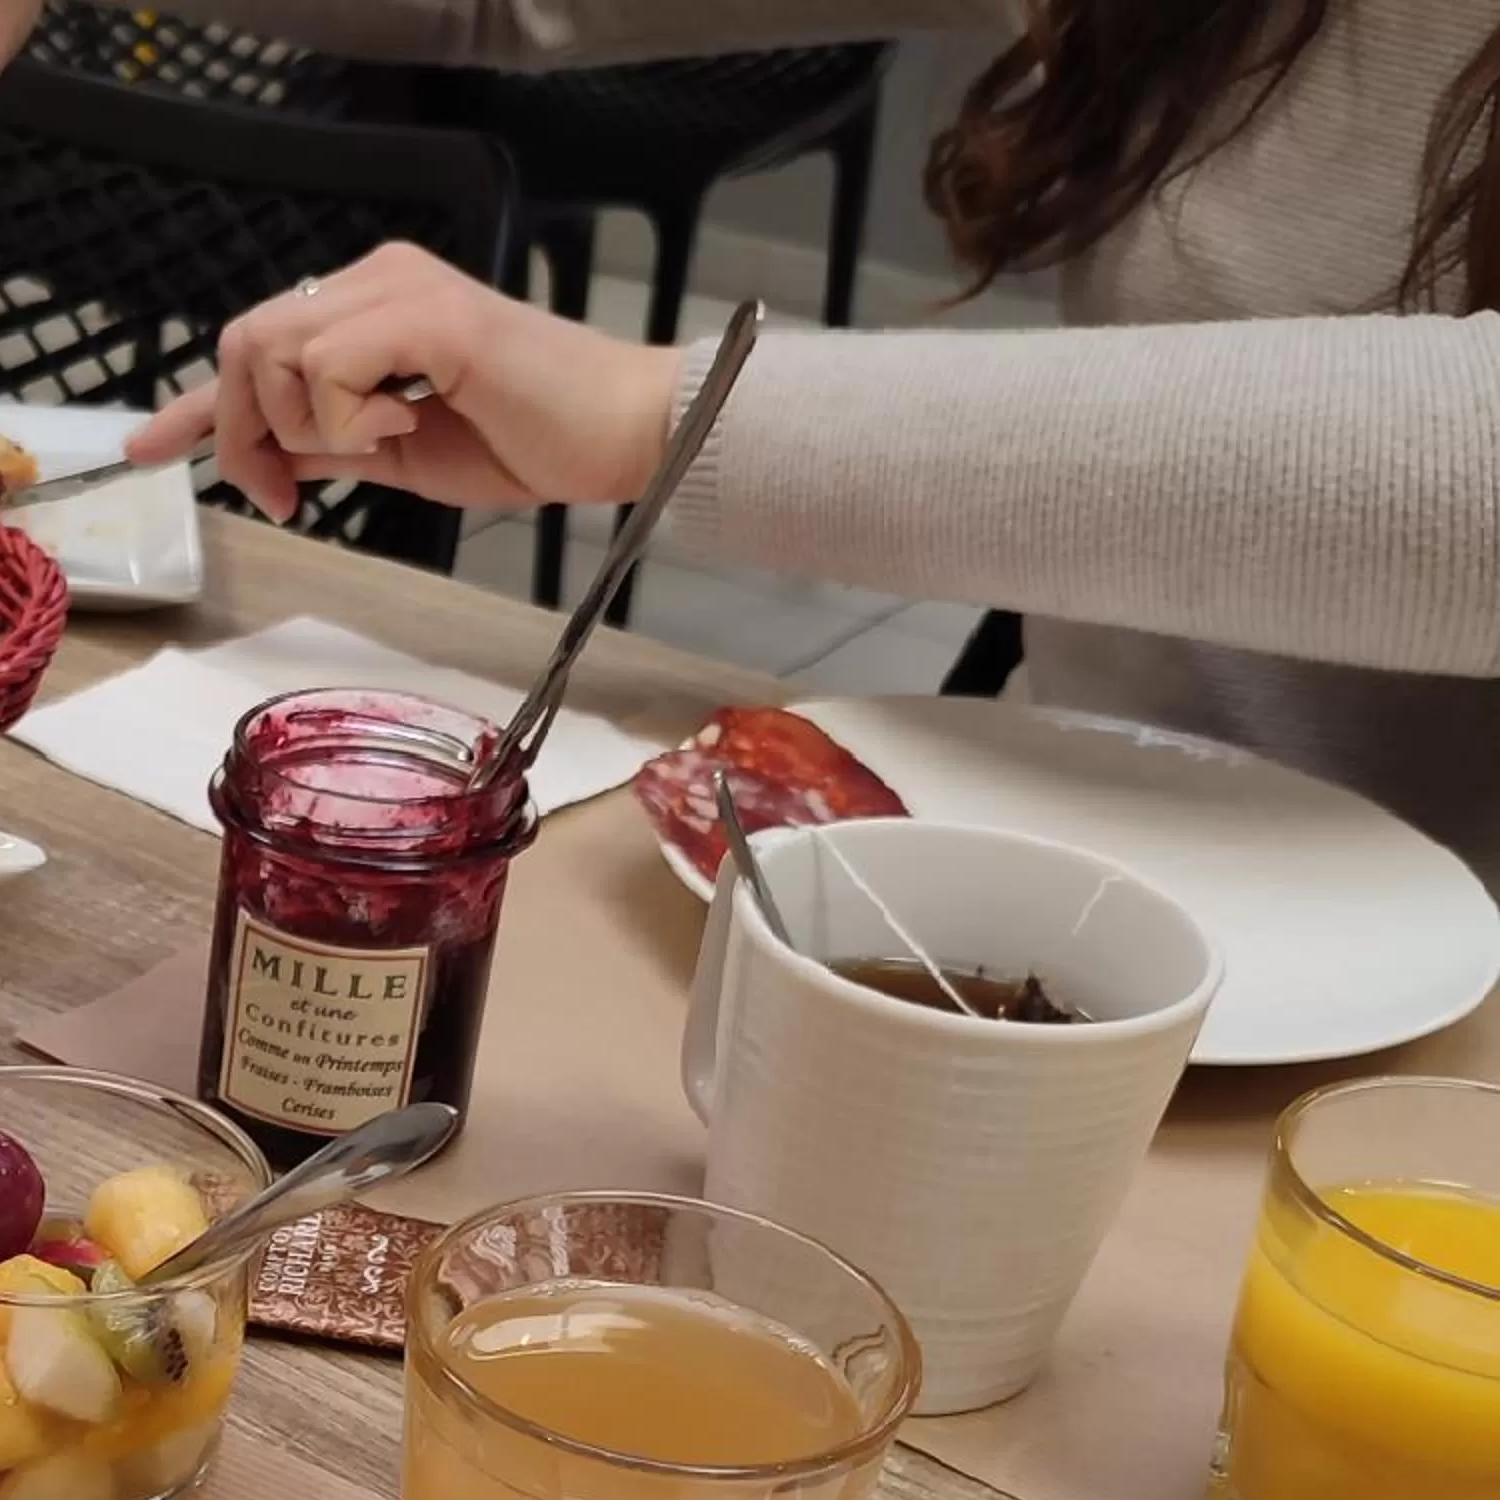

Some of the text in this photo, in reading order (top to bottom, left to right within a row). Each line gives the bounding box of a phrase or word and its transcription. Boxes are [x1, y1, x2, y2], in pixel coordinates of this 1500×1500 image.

[253, 948, 406, 1000] MILLE
[245, 1003, 400, 1048] Confitures
[290, 1000, 357, 1021] et une
[238, 1027, 290, 1058] Comme
[315, 1053, 403, 1078] Printemps
[303, 1078, 394, 1098] Framboises
[281, 1097, 336, 1120] Cerises
